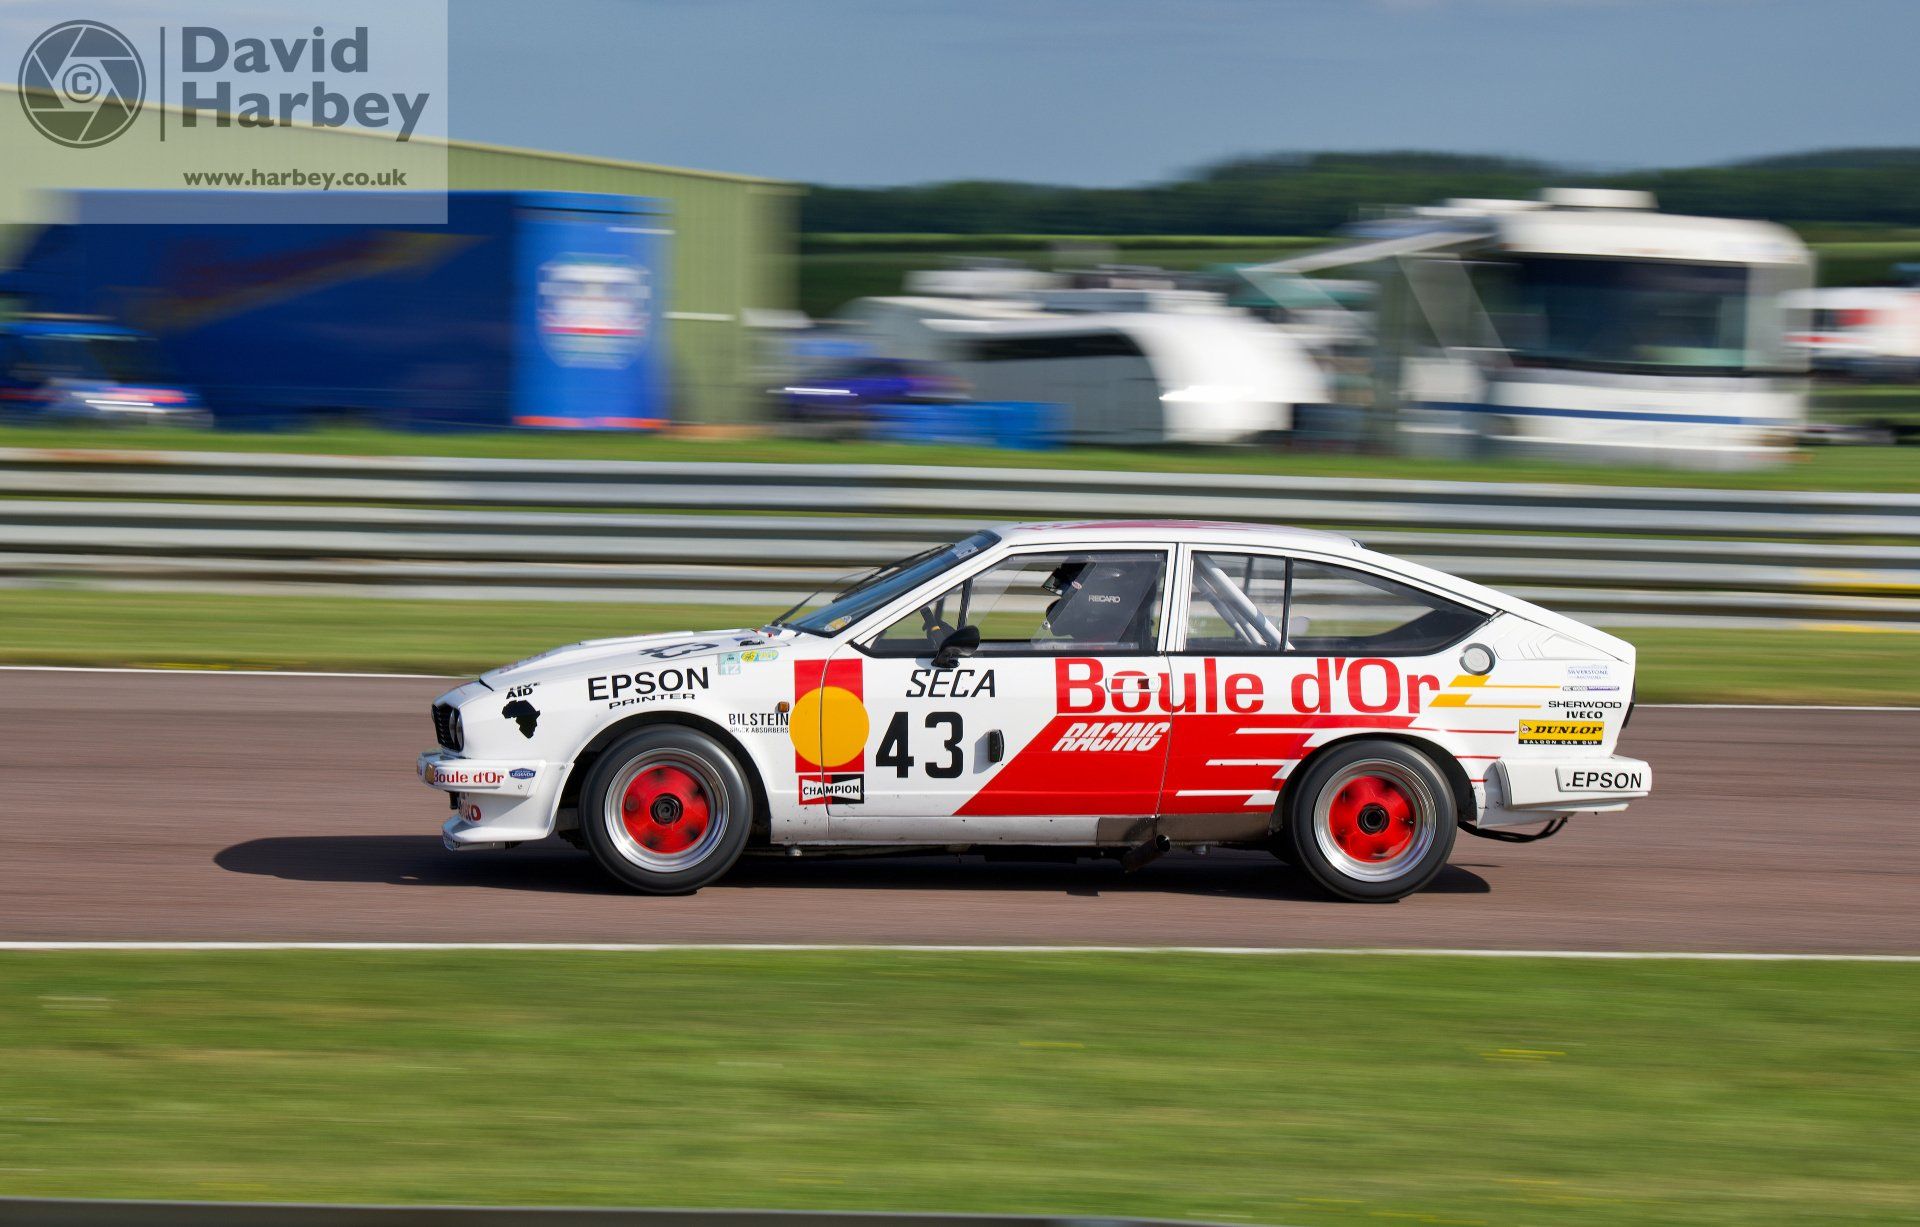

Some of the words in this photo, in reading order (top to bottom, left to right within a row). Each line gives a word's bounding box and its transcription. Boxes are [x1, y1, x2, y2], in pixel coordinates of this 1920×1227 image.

[1089, 595, 1121, 603] RECARO
[588, 667, 709, 701] EPSON
[906, 669, 995, 698] SECA
[1055, 657, 1264, 714] Boule
[1290, 657, 1440, 714] d'Or
[506, 687, 533, 699] AID
[609, 693, 695, 710] PRINTER
[1548, 701, 1622, 709] SHERWOOD
[728, 712, 789, 726] BILSTEIN
[1566, 711, 1603, 719] IVECO
[1052, 722, 1171, 753] RACING
[1534, 726, 1603, 735] DUNLOP
[875, 711, 964, 779] 43
[434, 770, 468, 784] Boule
[473, 771, 504, 784] d'Or
[803, 785, 860, 795] CHAMPION
